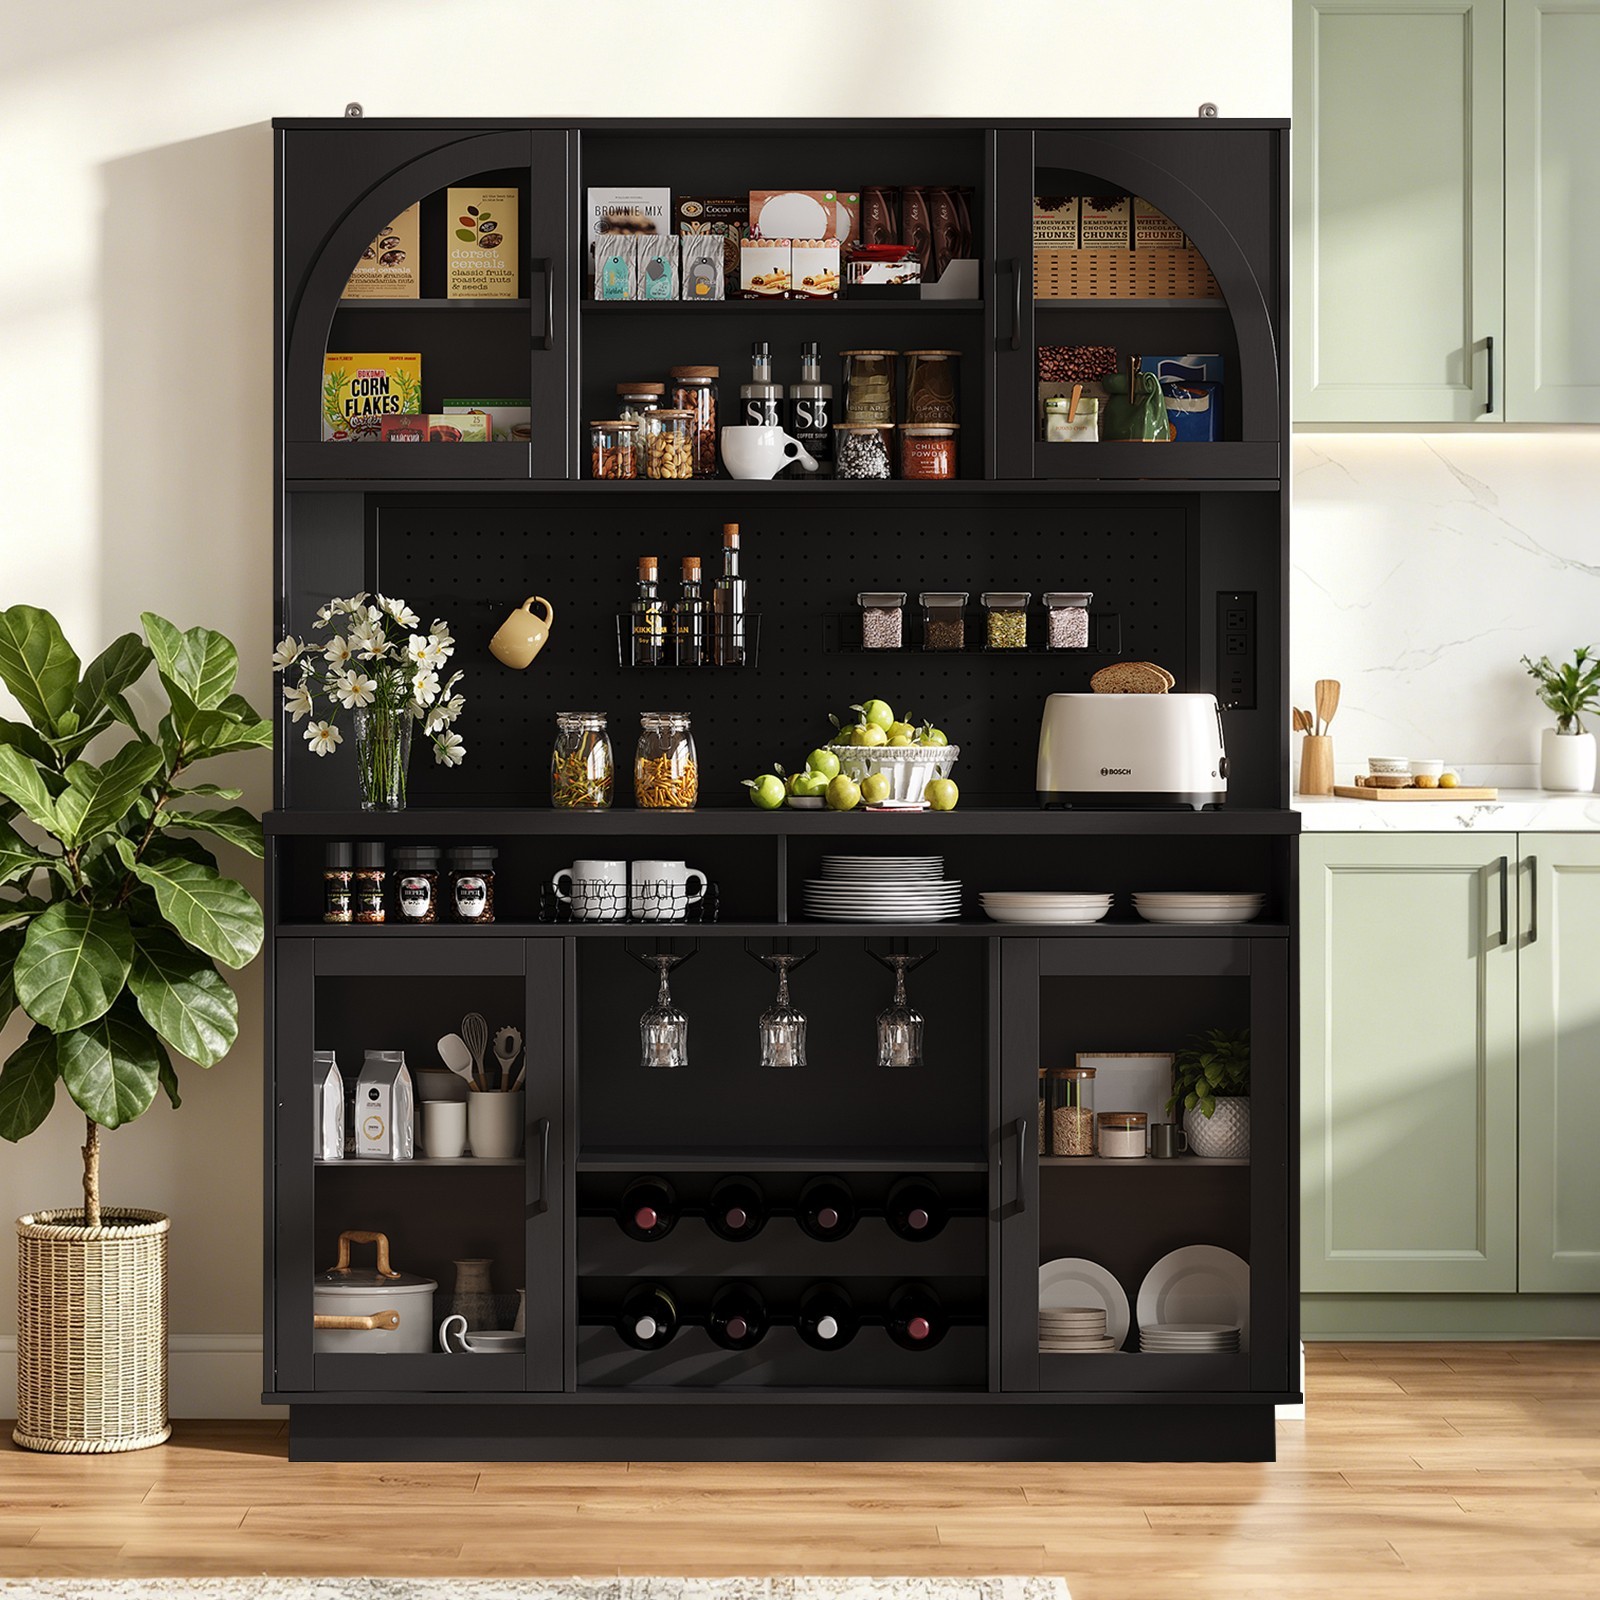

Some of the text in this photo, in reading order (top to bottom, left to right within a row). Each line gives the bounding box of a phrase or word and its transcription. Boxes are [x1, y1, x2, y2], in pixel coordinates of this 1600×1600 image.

[594, 205, 663, 217] BROWNIE MIX
[706, 205, 732, 213] Cocoa
[732, 205, 748, 213] rice
[1083, 231, 1128, 239] CHUNKS
[1136, 231, 1182, 239] CHUNKS
[451, 249, 499, 258] dorset
[451, 259, 505, 268] cereals
[485, 269, 515, 277] fruits,
[357, 370, 386, 378] BOKOMO
[351, 376, 390, 397] CORN
[345, 394, 400, 417] FLAKES
[745, 400, 779, 427] S3
[795, 400, 828, 429] S3
[472, 416, 481, 424] 25
